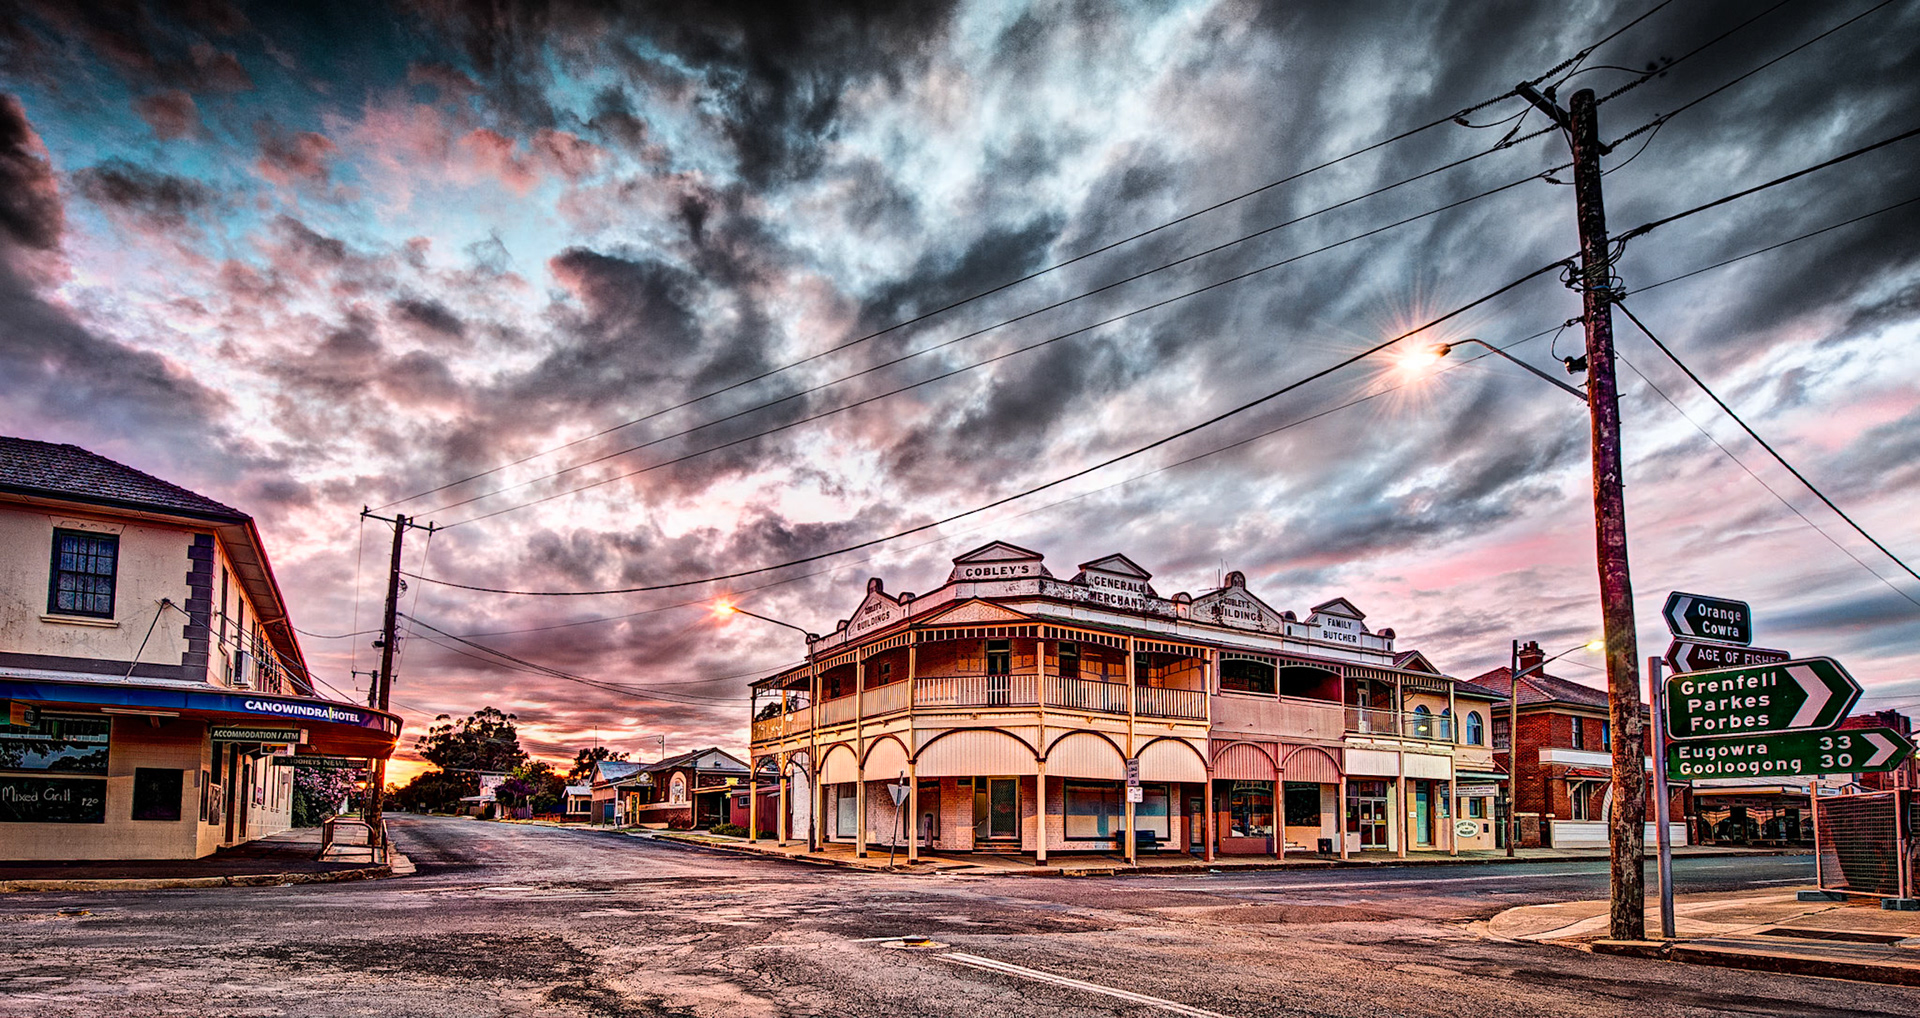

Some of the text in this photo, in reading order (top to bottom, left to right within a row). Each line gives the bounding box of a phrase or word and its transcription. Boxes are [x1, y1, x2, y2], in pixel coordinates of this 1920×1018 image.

[965, 565, 1030, 577] COBLEY'S
[1094, 576, 1141, 592] GENERAL
[1089, 591, 1145, 608] MERCHANT
[857, 611, 890, 630] BUILDINGS
[1211, 605, 1263, 622] BUILDINGS
[1698, 603, 1742, 624] Orange
[1327, 617, 1352, 629] FAMILY
[1702, 621, 1740, 637] Cowra
[1323, 630, 1357, 643] BUTCHER
[1697, 648, 1720, 662] AGE
[1725, 651, 1740, 664] OF
[1681, 671, 1777, 695] Grenfell
[245, 700, 360, 723] CANOWINDRA HOTEL
[1687, 695, 1771, 713] Parkes
[1690, 714, 1770, 731] Forbes
[213, 730, 278, 739] ACCOMMODATION
[282, 732, 299, 740] ATM
[1679, 735, 1852, 760] Eugowra 33
[323, 759, 345, 767] NEW
[1679, 753, 1853, 775] Gooloogong 30
[2, 785, 39, 802] Mixed
[43, 787, 71, 802] Grill
